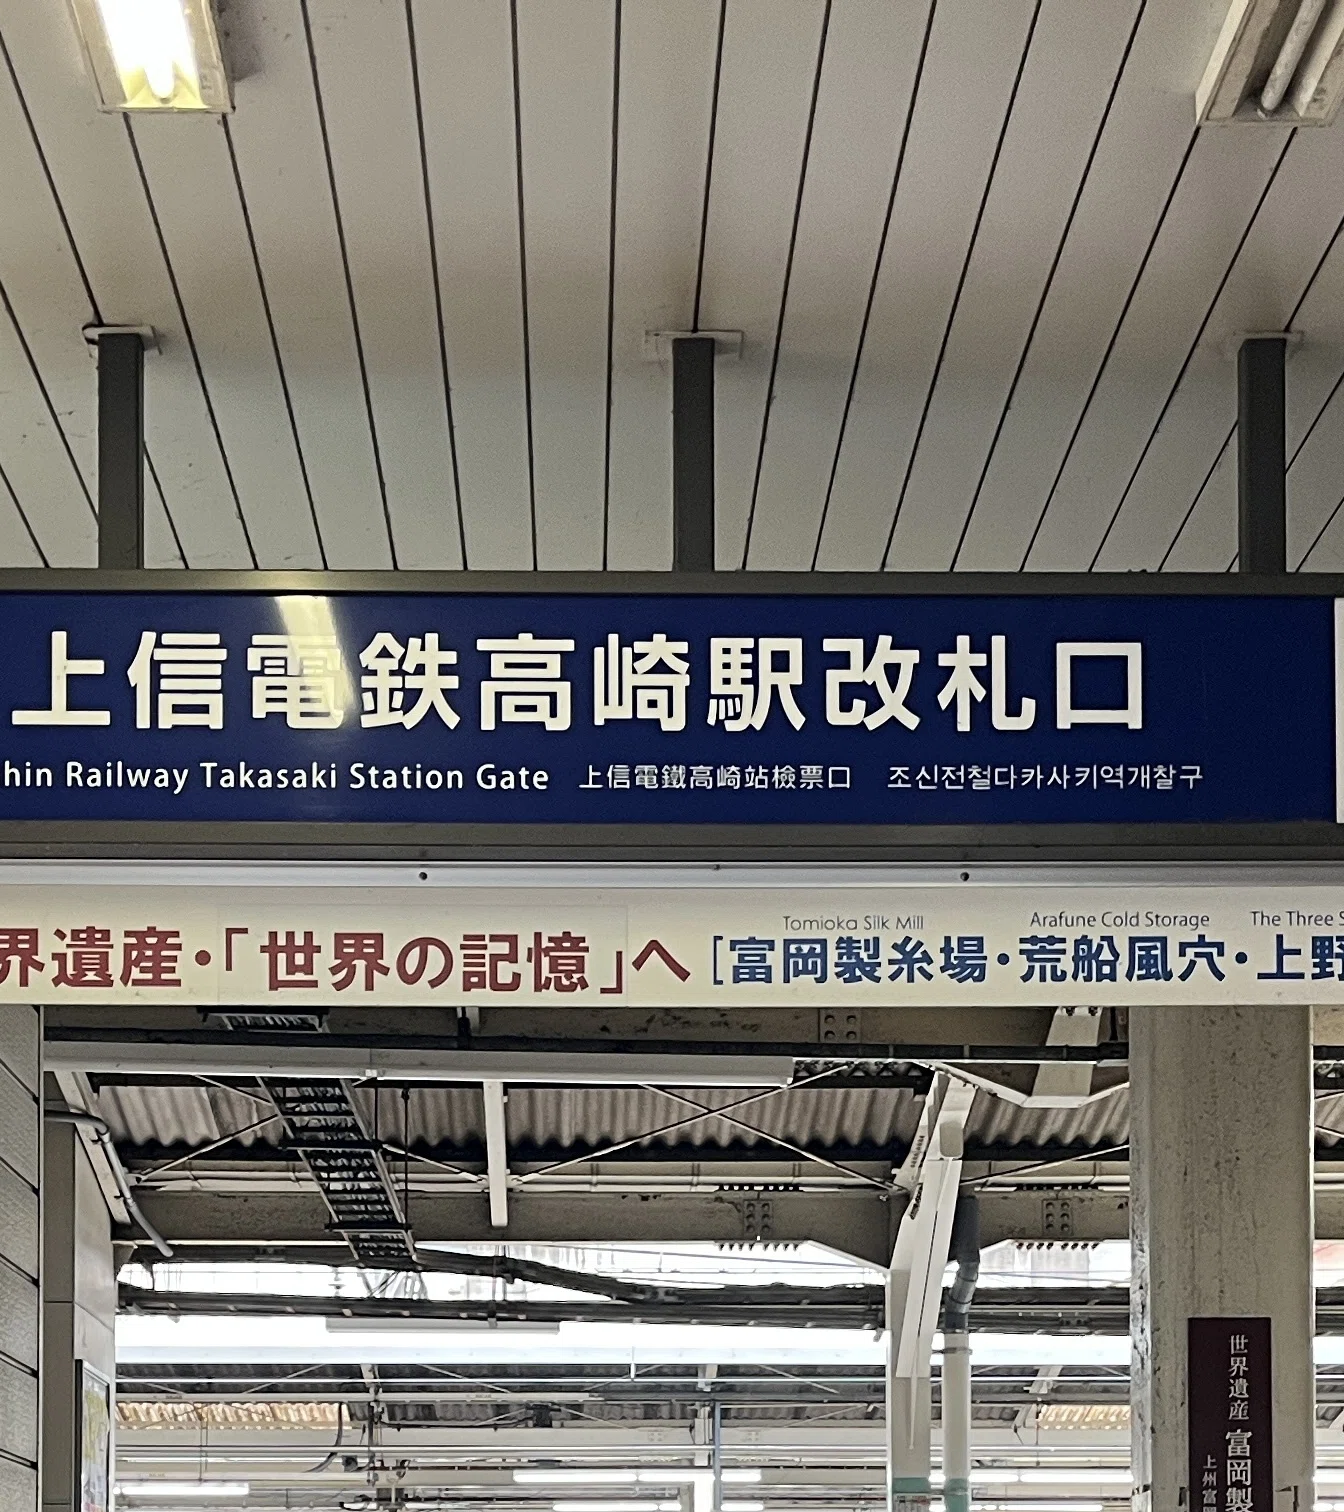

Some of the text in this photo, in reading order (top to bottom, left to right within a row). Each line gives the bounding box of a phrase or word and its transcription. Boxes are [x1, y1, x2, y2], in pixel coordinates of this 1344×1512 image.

[11, 630, 1144, 732] 上信電鉄高崎駅改札口
[65, 760, 189, 794] Railway
[200, 760, 339, 792] Takasaki
[349, 763, 464, 792] Station
[475, 763, 550, 792] Gate
[578, 764, 852, 791] 上信電鐵高崎站檢票口
[887, 764, 1205, 791] 조신전철다카사키역개찰구
[782, 914, 925, 931] Tomioka Silk Mill
[1030, 911, 1211, 931] Arafune Cold Storage
[1251, 911, 1281, 927] The
[1285, 911, 1334, 927] Three
[1228, 1333, 1250, 1421] 世界遺産
